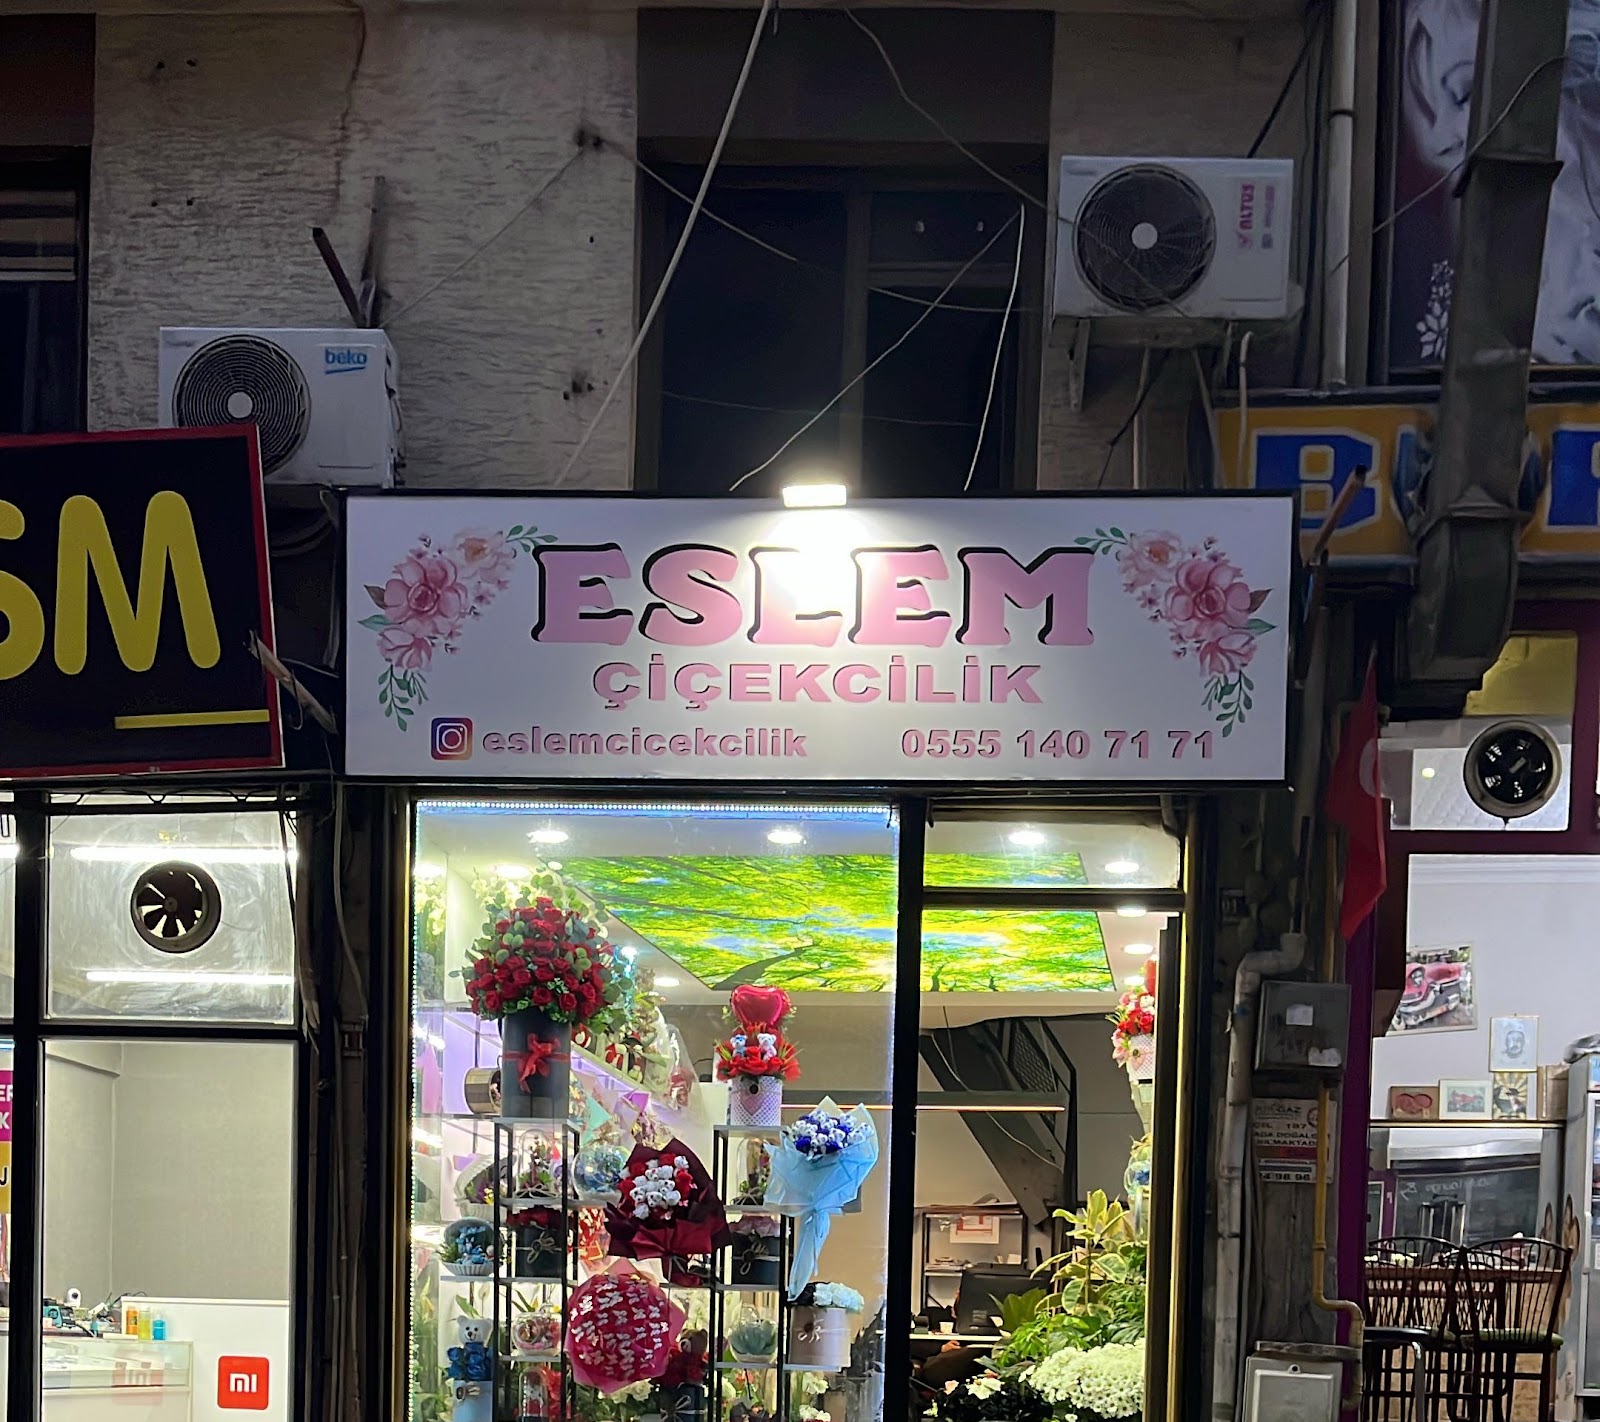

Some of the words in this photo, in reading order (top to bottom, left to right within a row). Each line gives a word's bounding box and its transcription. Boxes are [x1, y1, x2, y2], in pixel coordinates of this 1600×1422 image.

[325, 348, 367, 364] beko
[531, 542, 1094, 647] ESLEM
[592, 653, 1043, 711] ÇİÇEKCİLİK
[482, 725, 808, 758] eslemcicekcilik
[901, 729, 1001, 759] 0555
[1016, 729, 1091, 759] 140
[1104, 729, 1150, 759] 71
[1167, 729, 1214, 759] 71
